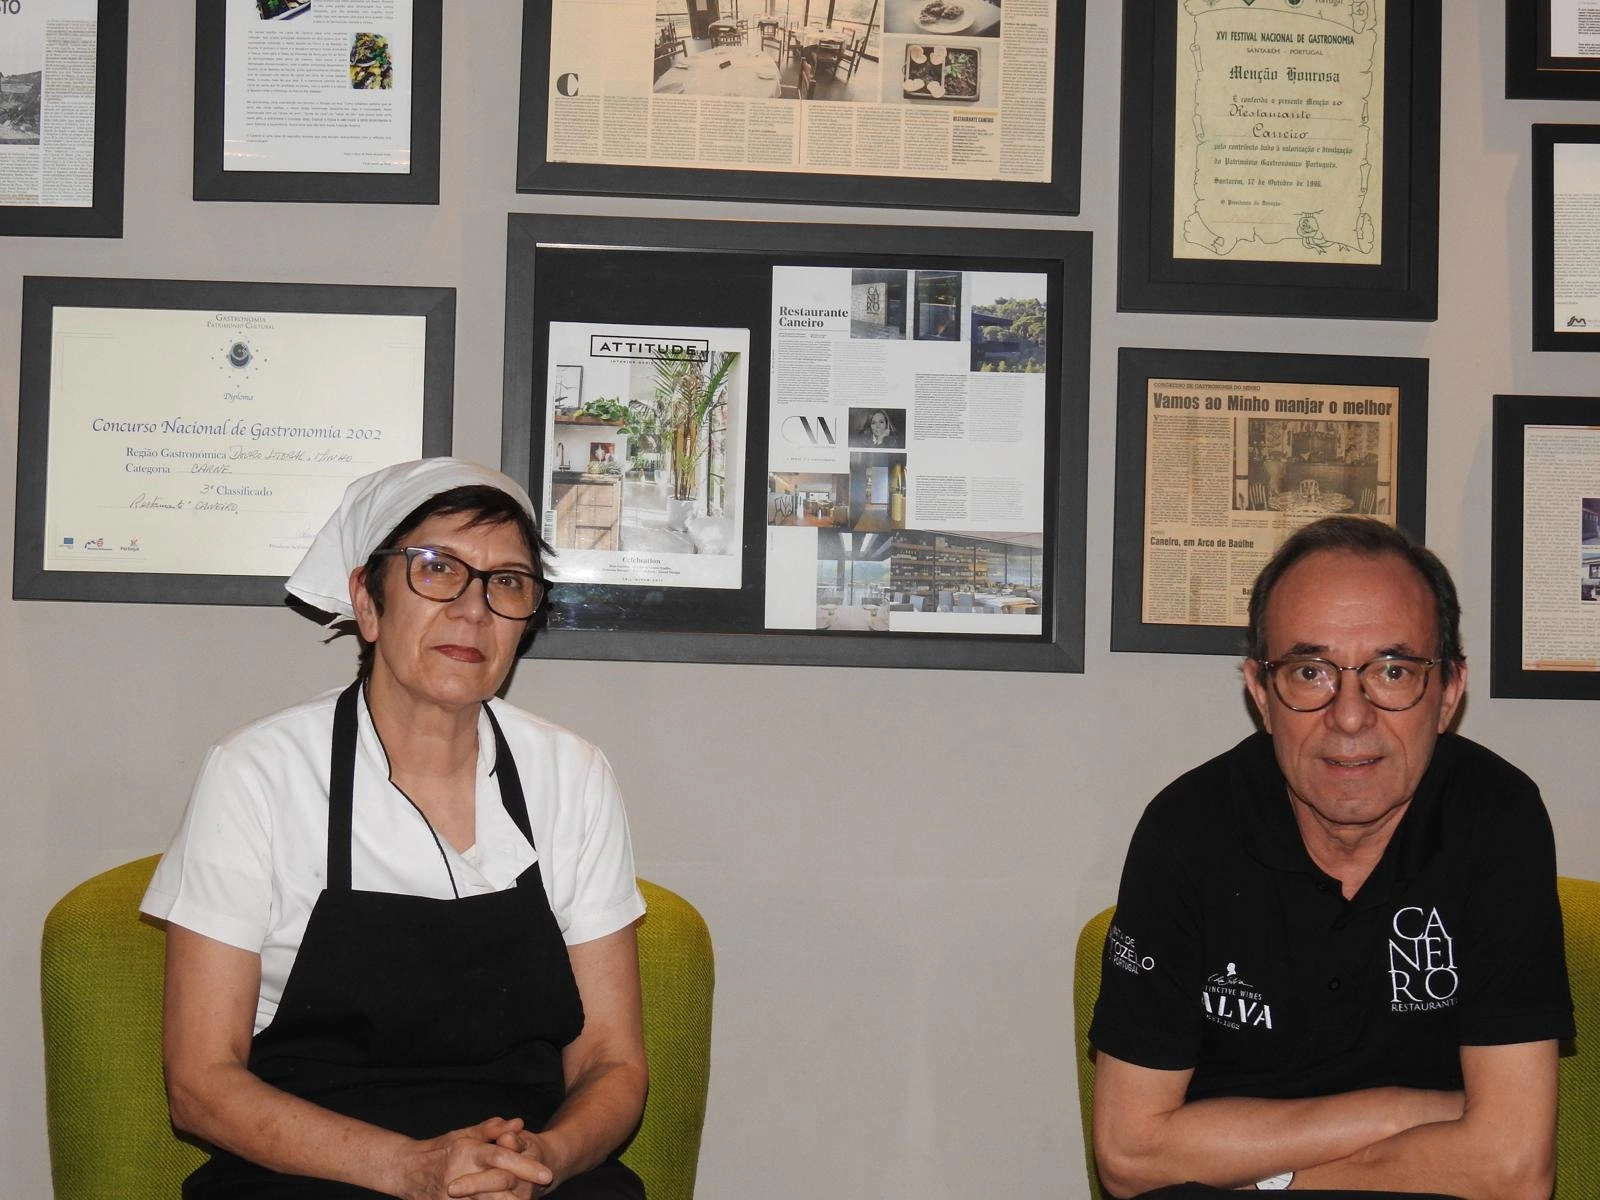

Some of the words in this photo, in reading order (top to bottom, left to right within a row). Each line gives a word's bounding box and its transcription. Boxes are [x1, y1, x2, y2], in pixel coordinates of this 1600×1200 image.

[1216, 31, 1228, 41] XVI
[1231, 31, 1257, 42] FESTIVAL
[1261, 33, 1294, 43] NACIONAL
[1297, 34, 1305, 43] DE
[1308, 34, 1355, 45] GASTRONOMIA
[1229, 65, 1278, 83] Menção
[1286, 66, 1340, 84] Honrosa
[1229, 103, 1311, 119] Restaurante
[1252, 122, 1308, 139] Caneiro
[779, 306, 849, 318] Restaurante
[779, 316, 824, 328] Caneiro
[600, 341, 697, 356] ATTITUDE
[223, 392, 253, 402] Diploma
[1153, 392, 1200, 410] Vamos
[1205, 396, 1222, 410] ao
[1227, 394, 1270, 412] Minho
[1275, 397, 1324, 415] manjar
[1329, 400, 1338, 414] o
[1343, 399, 1393, 416] melhor
[92, 418, 157, 433] Concurso
[160, 416, 231, 436] Nacional
[231, 419, 246, 435] de
[250, 422, 341, 440] Gastronomia
[345, 428, 382, 440] 2002
[126, 447, 158, 459] Região
[160, 448, 227, 460] Gastronómica
[125, 463, 171, 475] Categoria
[216, 485, 273, 497] Classificado
[1150, 536, 1181, 547] Caneiro,
[1183, 538, 1195, 547] em
[1197, 538, 1215, 547] Arco
[1217, 538, 1226, 547] de
[1240, 990, 1262, 1001] WINES
[1391, 998, 1459, 1012] RESTAURANT
